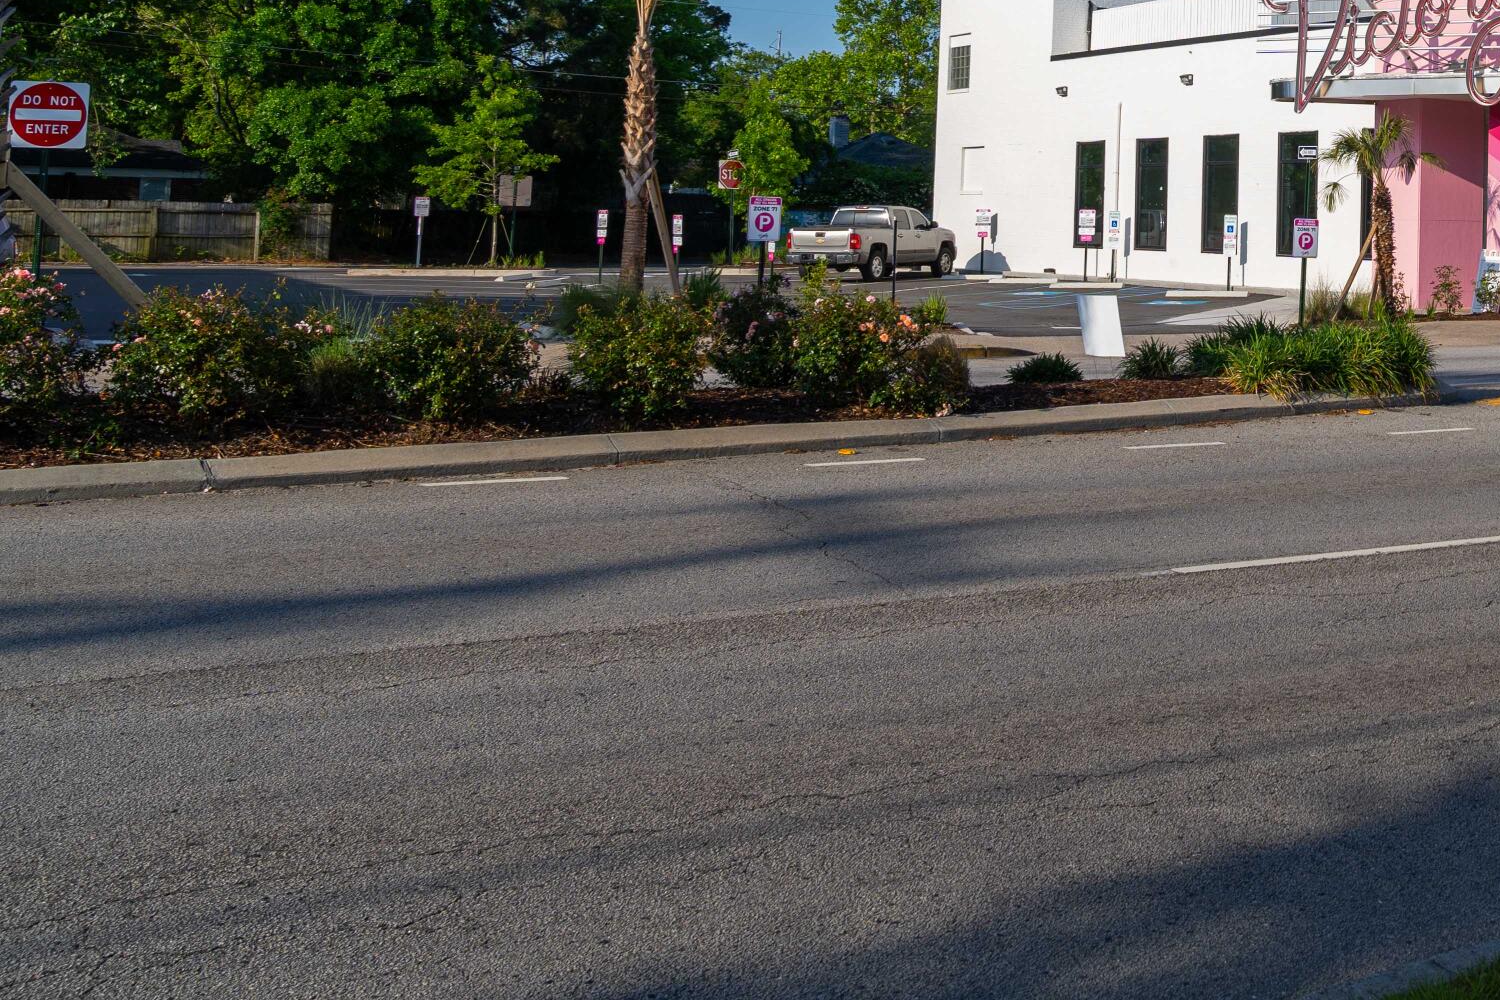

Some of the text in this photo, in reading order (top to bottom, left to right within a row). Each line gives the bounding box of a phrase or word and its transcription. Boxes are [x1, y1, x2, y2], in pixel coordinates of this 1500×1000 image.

[23, 95, 77, 106] DO NOT
[25, 123, 69, 135] ENTER
